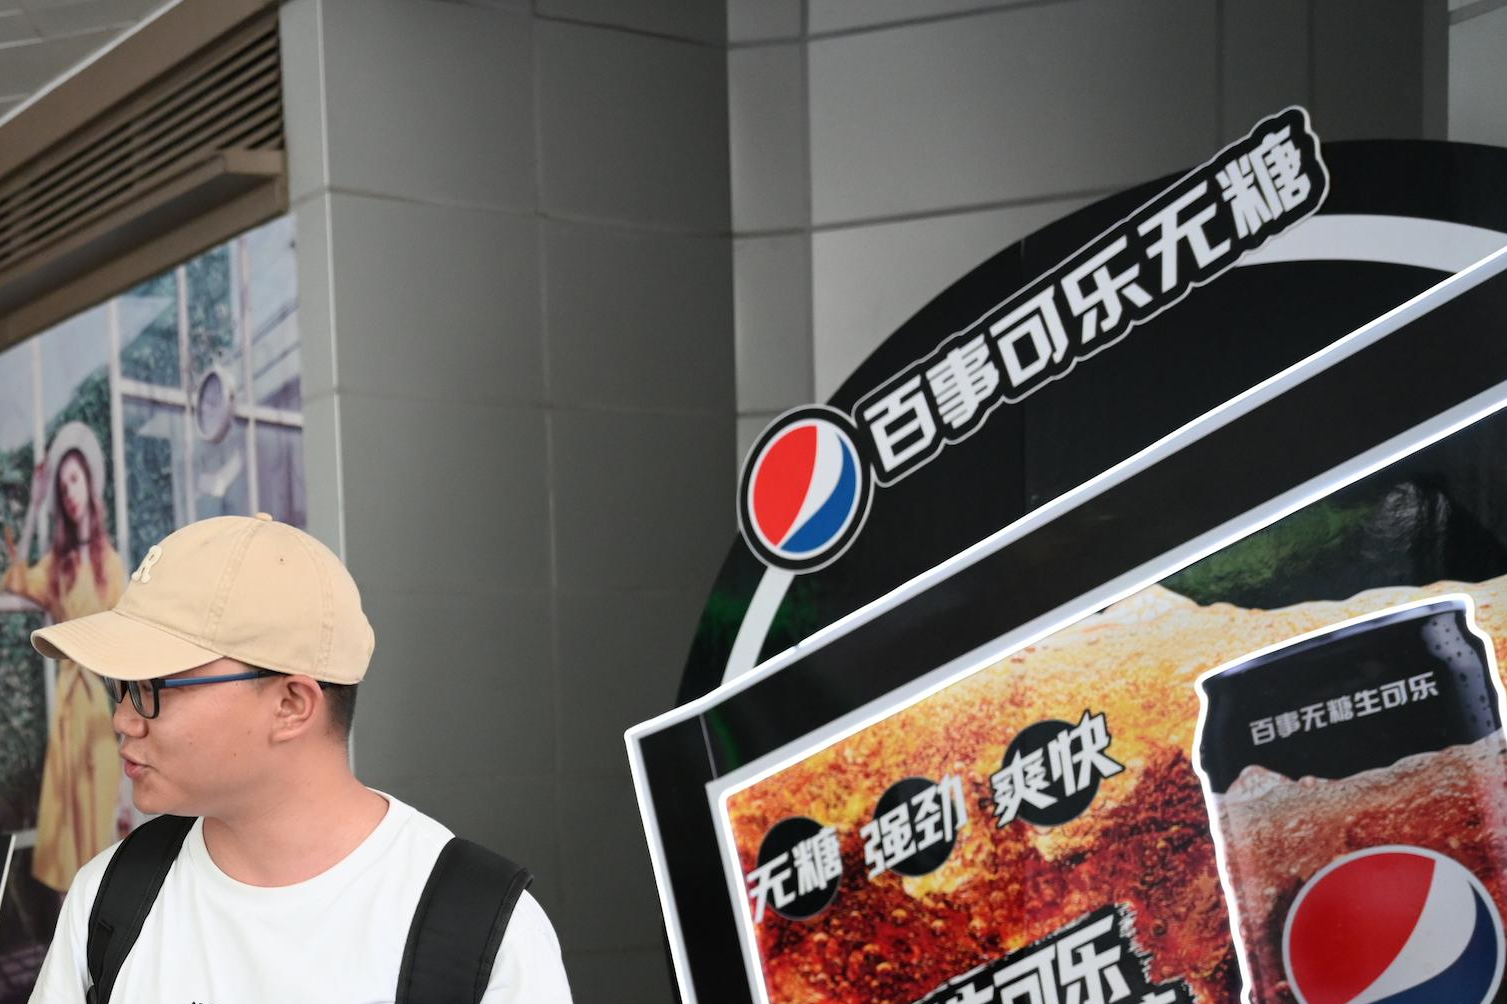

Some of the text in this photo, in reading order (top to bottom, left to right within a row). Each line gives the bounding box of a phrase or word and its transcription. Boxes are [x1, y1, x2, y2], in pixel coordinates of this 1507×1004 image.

[861, 123, 1312, 475] 百事可乐无糖
[1249, 671, 1439, 746] 百事无糖生可乐
[746, 710, 1126, 924] 无糖 强劲 爽快
